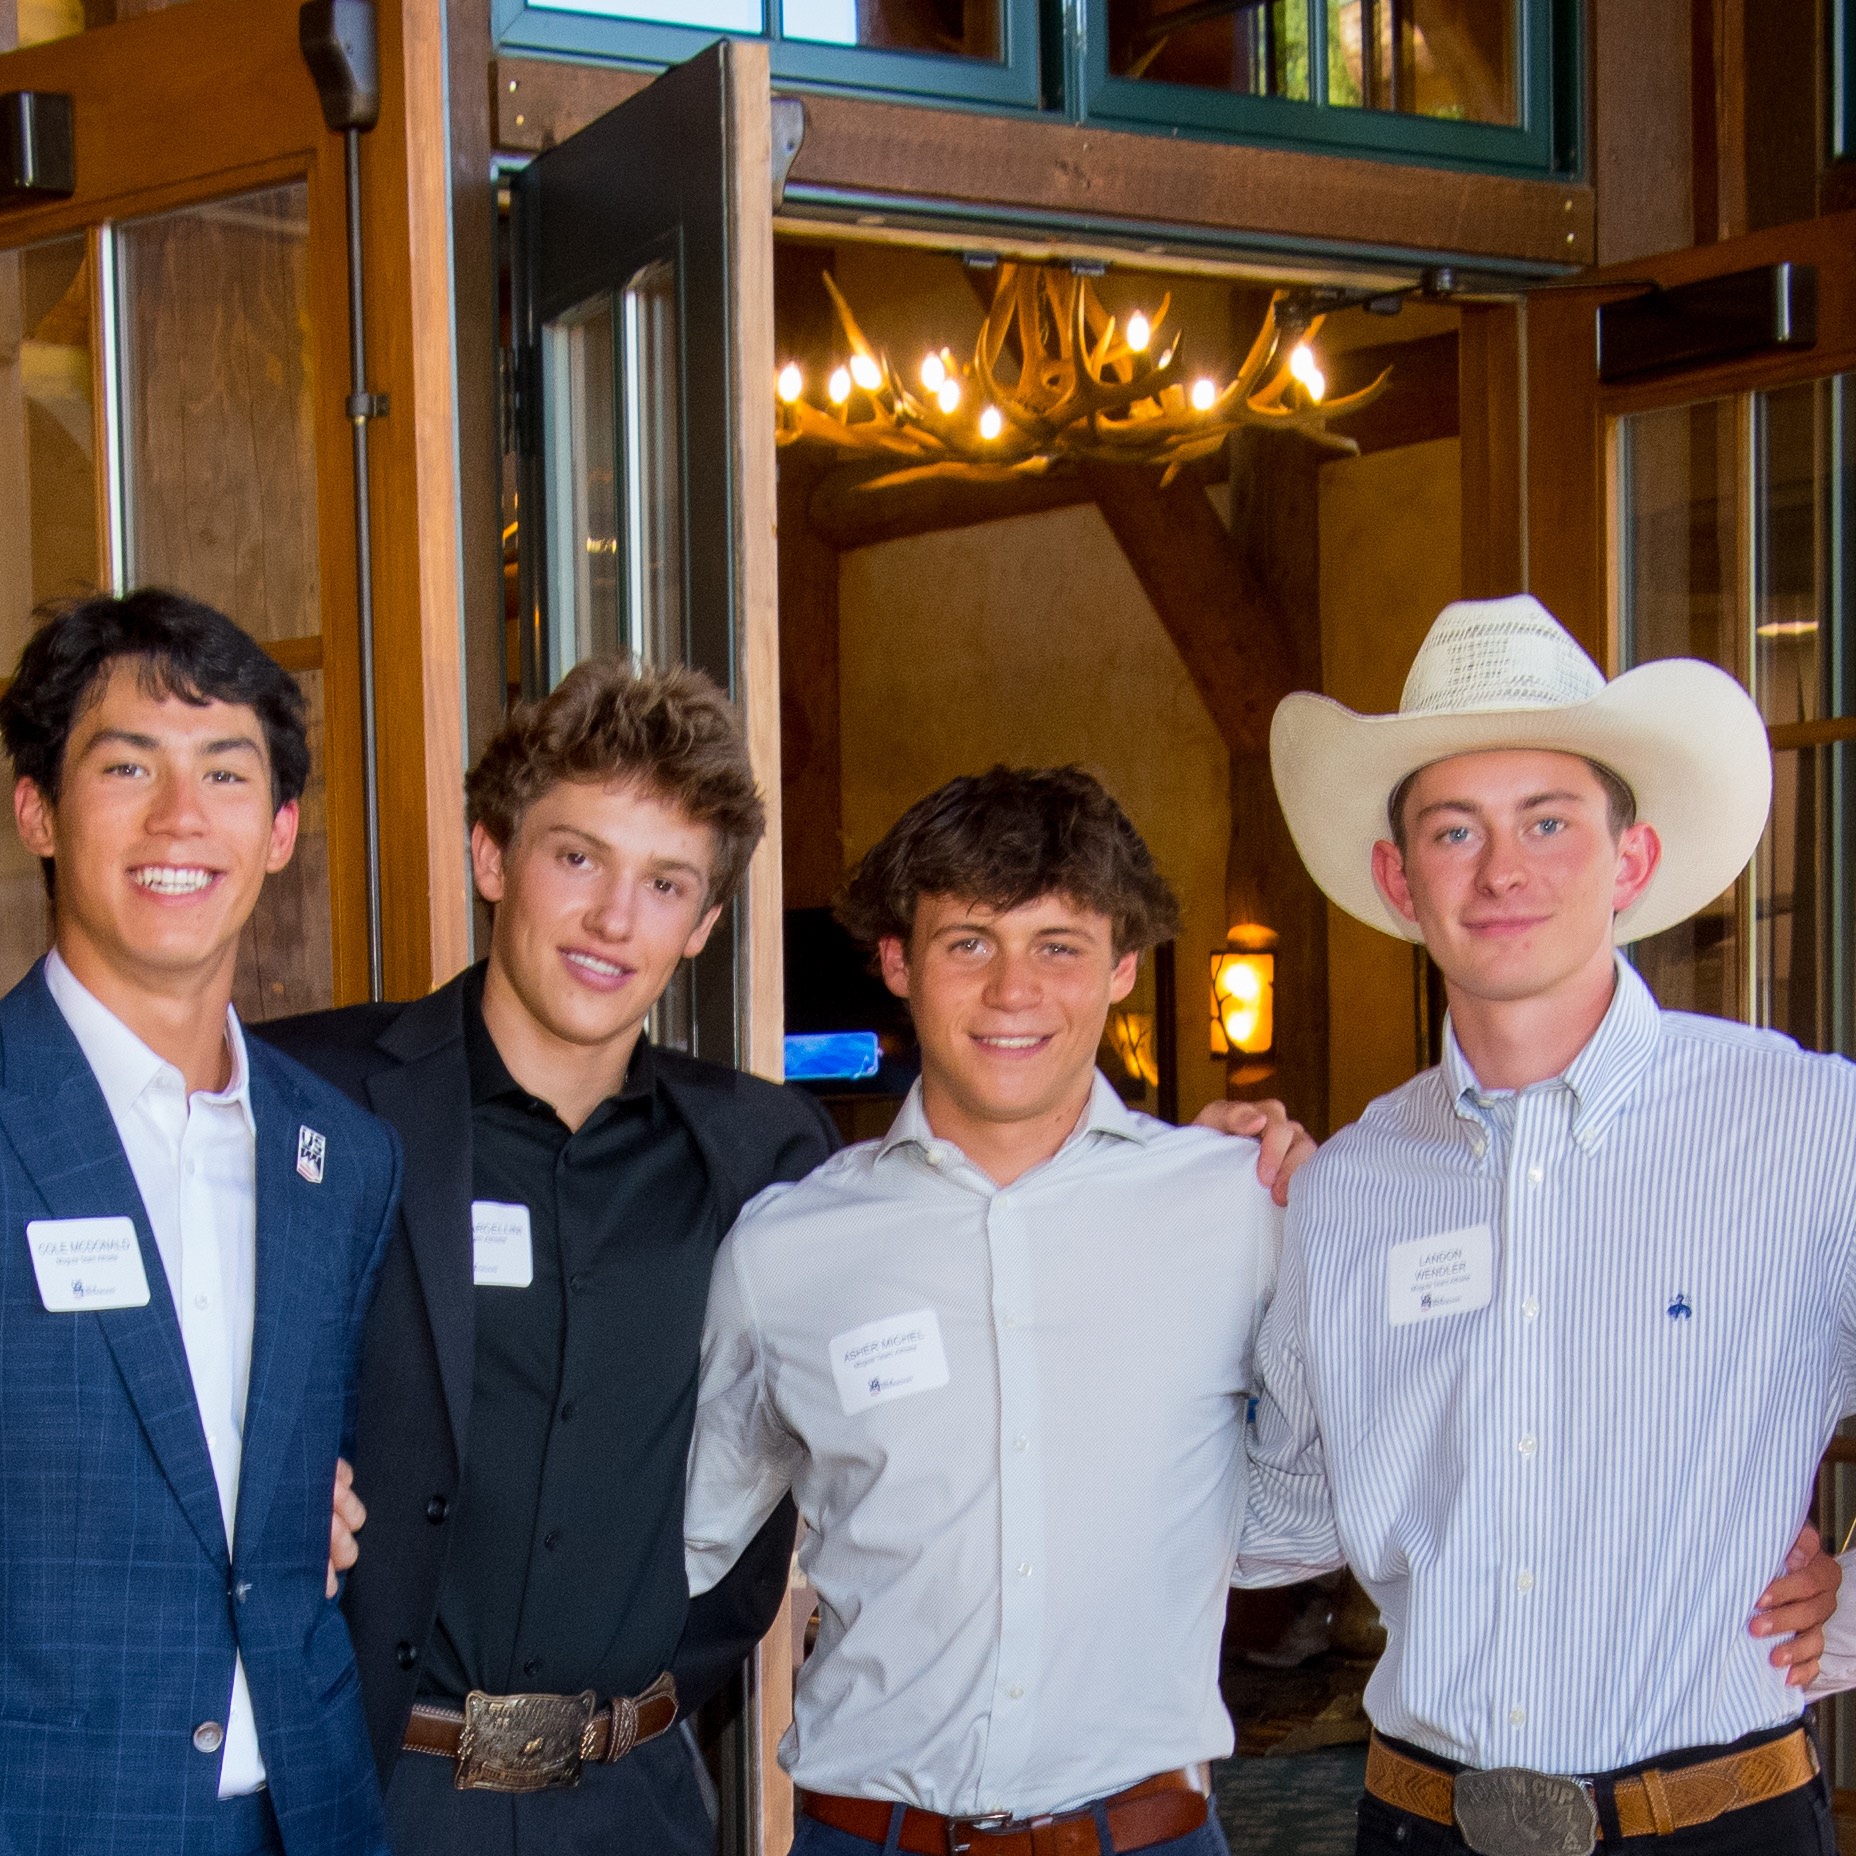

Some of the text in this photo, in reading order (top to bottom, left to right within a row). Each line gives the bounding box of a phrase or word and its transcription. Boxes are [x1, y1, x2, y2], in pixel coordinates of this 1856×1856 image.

[1419, 1248, 1462, 1267] LANDON
[1414, 1261, 1466, 1281] WENDLER
[844, 1329, 926, 1363] ASHER MICHEL
[1532, 1777, 1576, 1804] CUP
